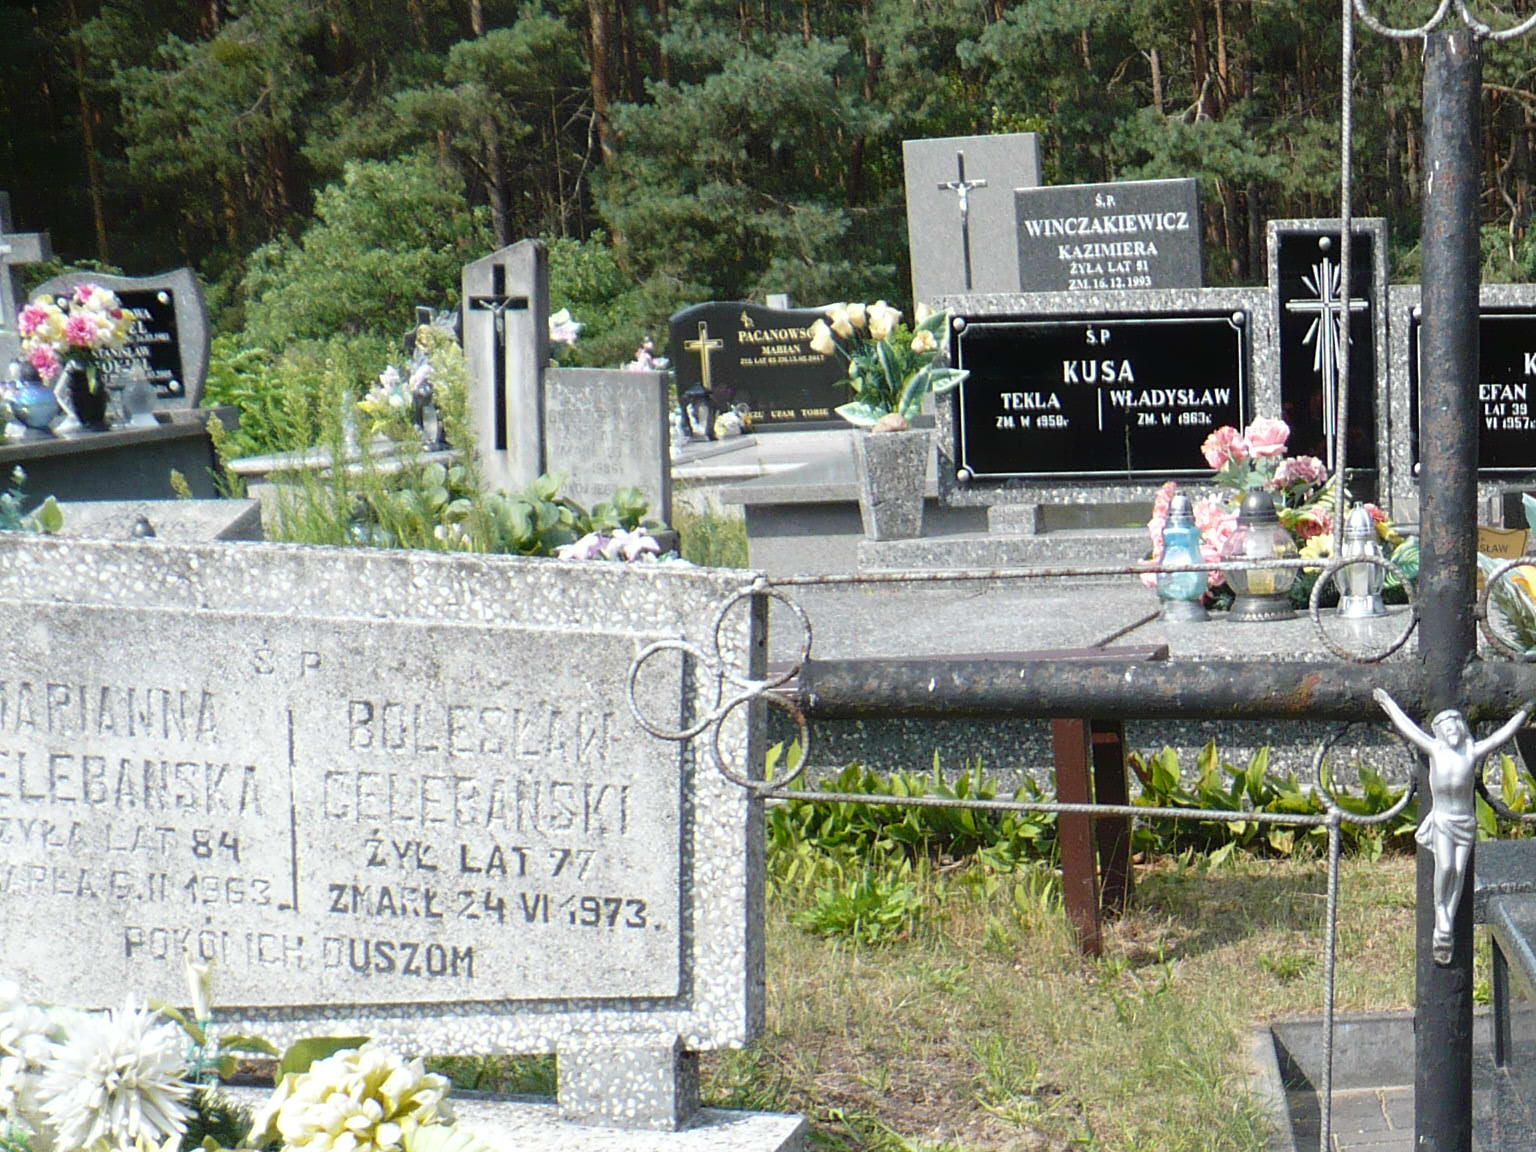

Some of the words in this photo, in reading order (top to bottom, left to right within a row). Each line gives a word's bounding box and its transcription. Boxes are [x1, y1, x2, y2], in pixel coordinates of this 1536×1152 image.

[1024, 212, 1189, 237] WINCZAKIEWICZ
[1058, 241, 1158, 260] KAZIMIERA
[1069, 261, 1103, 274] ŻYŁA
[1107, 260, 1132, 273] LAT
[1063, 360, 1134, 383] KUSA
[1000, 392, 1060, 409] TEKLA
[1110, 388, 1231, 407] WŁADYSŁAW
[1478, 383, 1527, 400] EFAN
[1484, 403, 1505, 415] LAT
[1511, 403, 1527, 415] 39
[1020, 416, 1030, 427] W
[1161, 413, 1171, 425] W
[1485, 417, 1499, 429] VI
[350, 699, 615, 762] BOLESŁAW
[106, 822, 176, 856] LAT
[192, 829, 241, 863] 84
[365, 828, 438, 873] ŻYŁ
[459, 844, 531, 877] LAT
[551, 848, 597, 881] 77
[329, 884, 443, 919] ZMARŁ
[457, 888, 505, 924] 24
[521, 892, 550, 924] VI
[247, 931, 304, 969] ICH
[322, 936, 477, 978] DUSZOM
